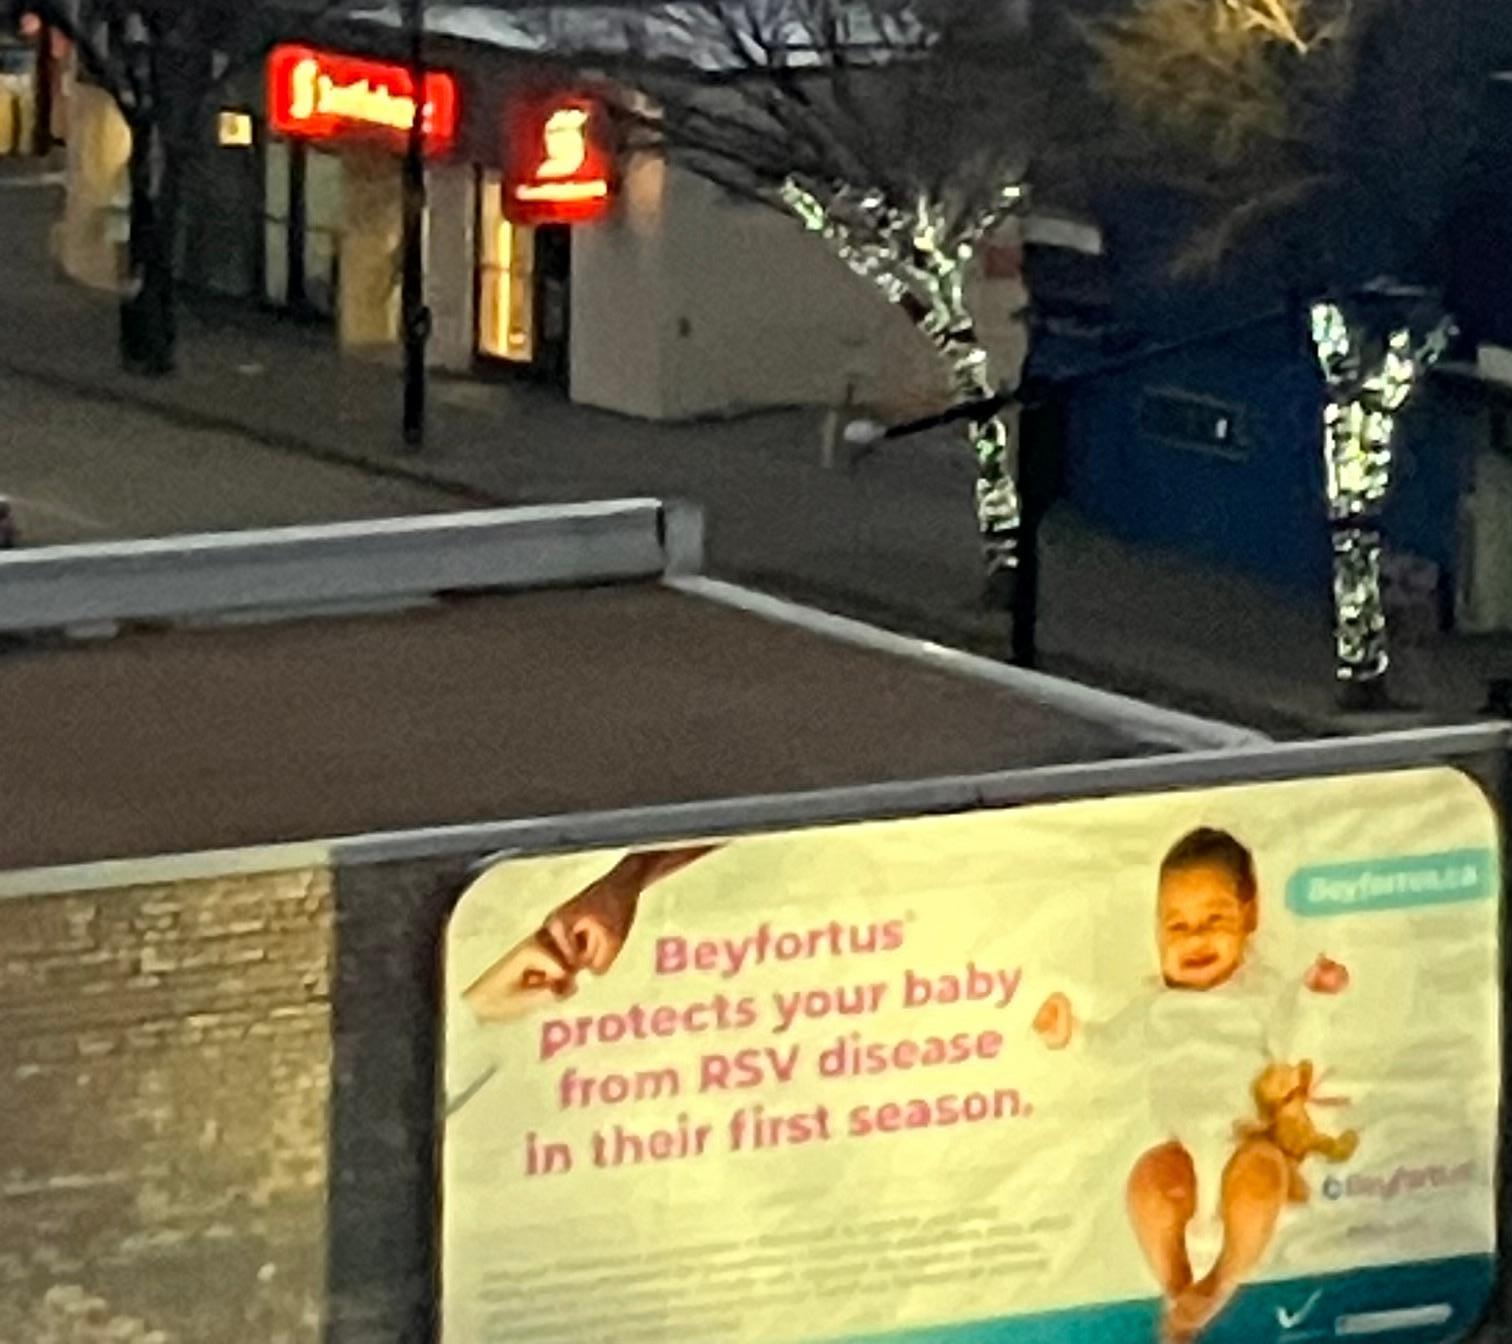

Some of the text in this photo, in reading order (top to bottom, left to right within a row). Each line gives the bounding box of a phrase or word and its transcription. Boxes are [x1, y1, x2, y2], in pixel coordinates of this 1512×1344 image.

[655, 918, 904, 979] Beyfortus
[539, 961, 1023, 1061] protects your baby
[559, 1028, 1004, 1110] from RSV disease
[524, 1087, 1035, 1176] in their first season.
